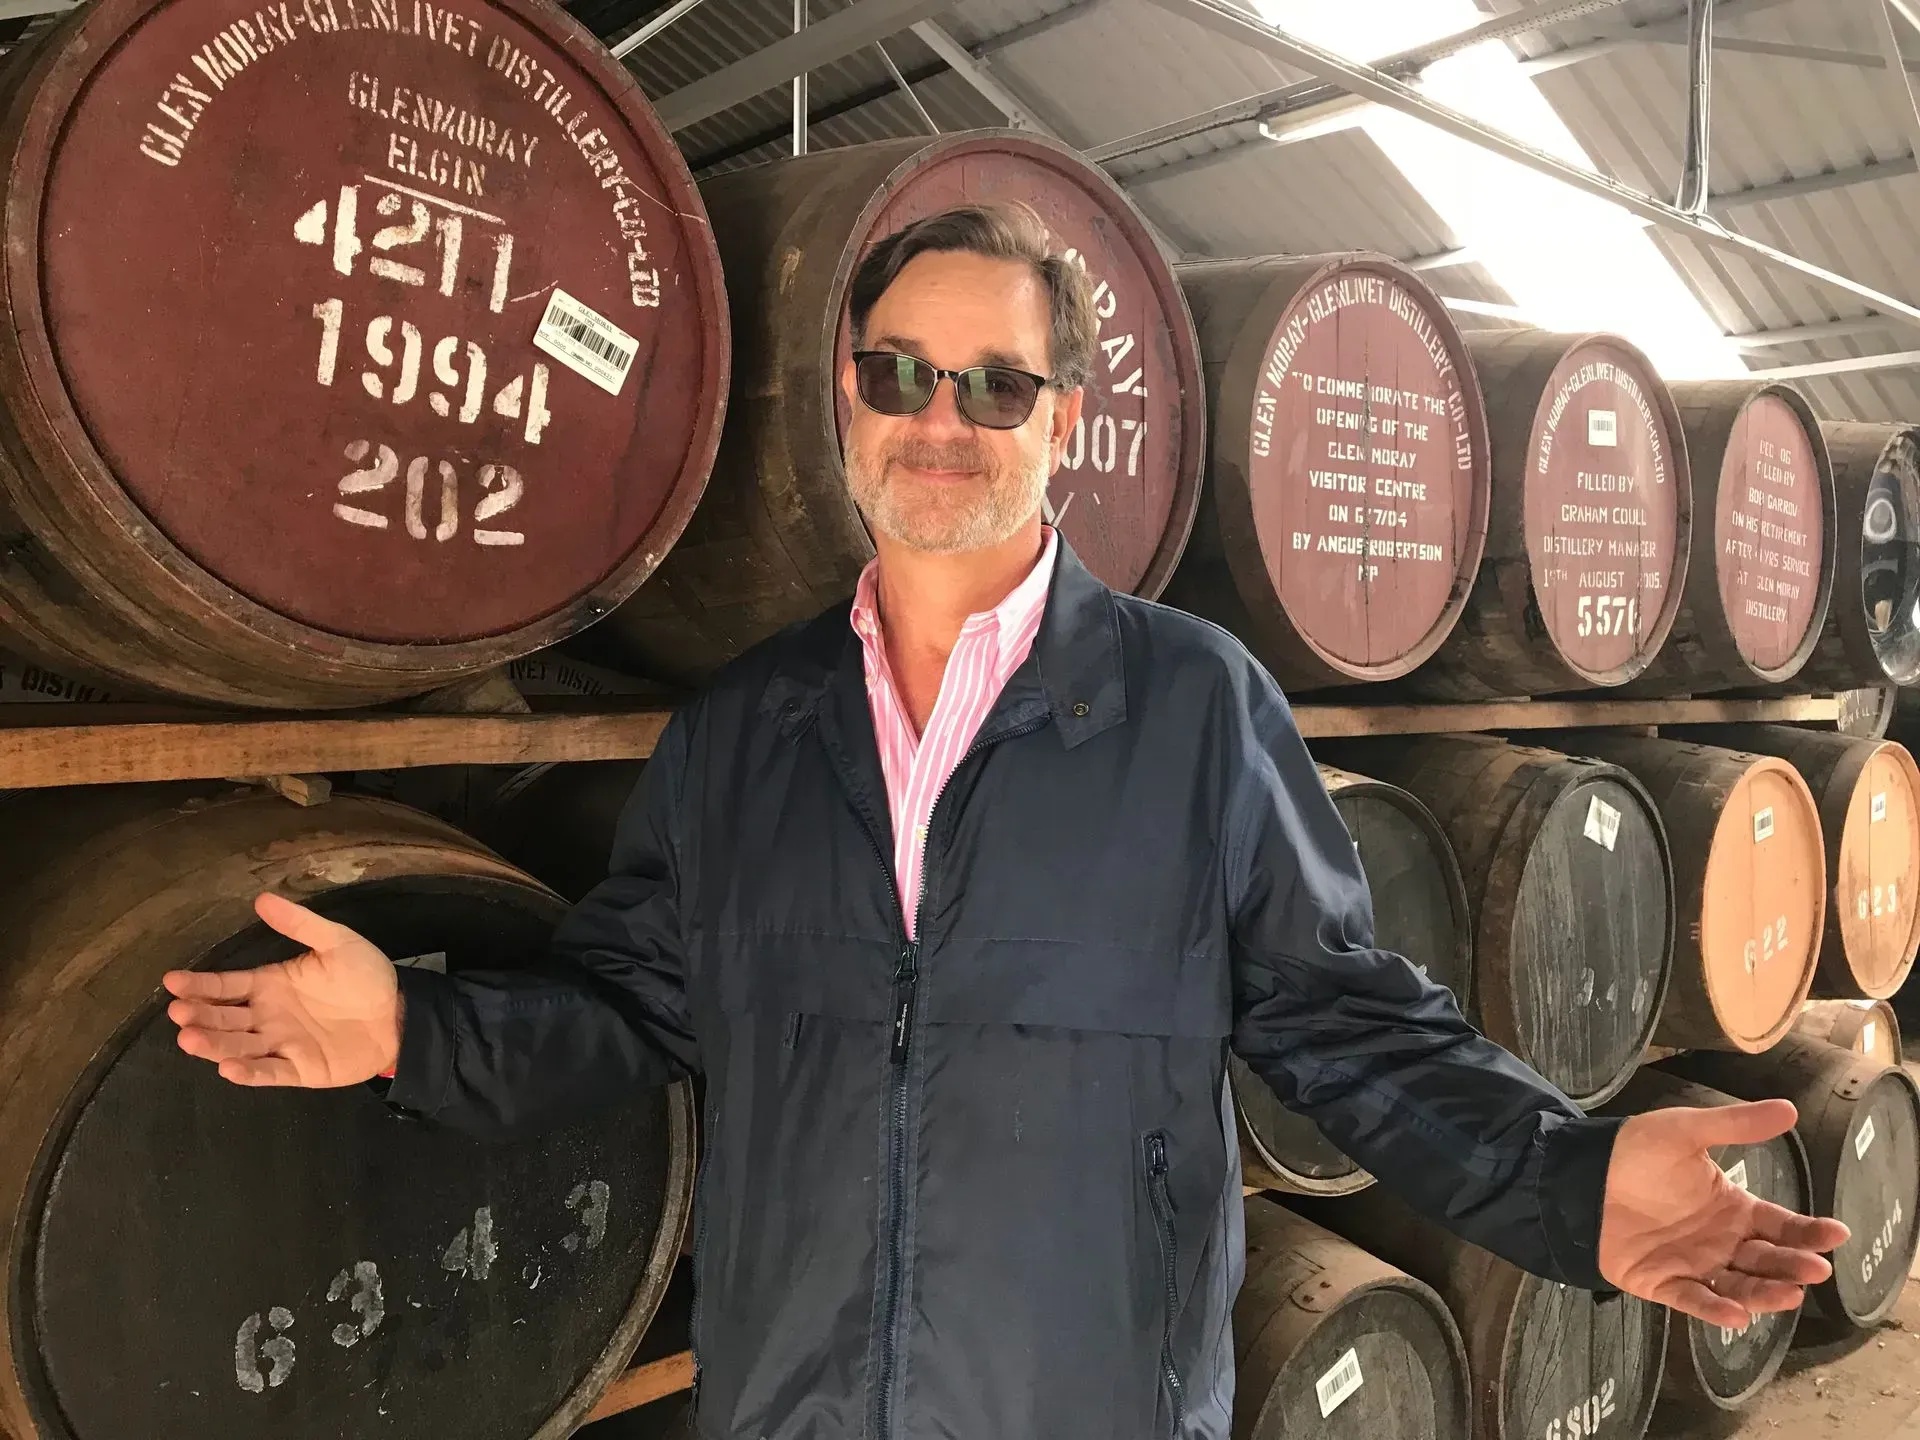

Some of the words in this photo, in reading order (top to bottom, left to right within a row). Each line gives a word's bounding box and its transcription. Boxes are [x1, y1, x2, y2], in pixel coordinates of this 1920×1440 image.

[140, 73, 212, 166] GLEN
[388, 132, 485, 196] ELGIN
[313, 298, 551, 445] 1994
[1422, 395, 1446, 416] THE
[1252, 391, 1277, 458] GLEN
[1382, 418, 1400, 436] OF
[1405, 422, 1429, 442] THE
[1328, 441, 1366, 462] GLEN
[1371, 448, 1417, 469] MORAY
[1538, 431, 1553, 474] GLEN
[332, 439, 525, 546] 202
[1309, 470, 1367, 494] VISITOR
[1375, 478, 1427, 501] CENTRE
[1577, 472, 1615, 491] FILLED
[1618, 475, 1634, 493] BY
[1329, 504, 1349, 523] ON
[1561, 504, 1608, 523] GRAHAM
[1612, 507, 1647, 526] COULL
[1732, 510, 1745, 528] ON
[1745, 514, 1759, 533] HIS
[1761, 520, 1808, 548] RETIREMENT
[1292, 531, 1311, 551] BY
[1317, 535, 1364, 555] ANGUS
[1368, 539, 1443, 562] ROBERTSON
[1543, 535, 1604, 556] DISTILLERY
[1608, 540, 1656, 558] MANAGER
[1725, 539, 1753, 560] AFTER
[1782, 555, 1811, 577] SERVICE
[1578, 571, 1625, 589] AUGUST
[1737, 570, 1749, 585] AT
[1776, 581, 1800, 600] MORAY
